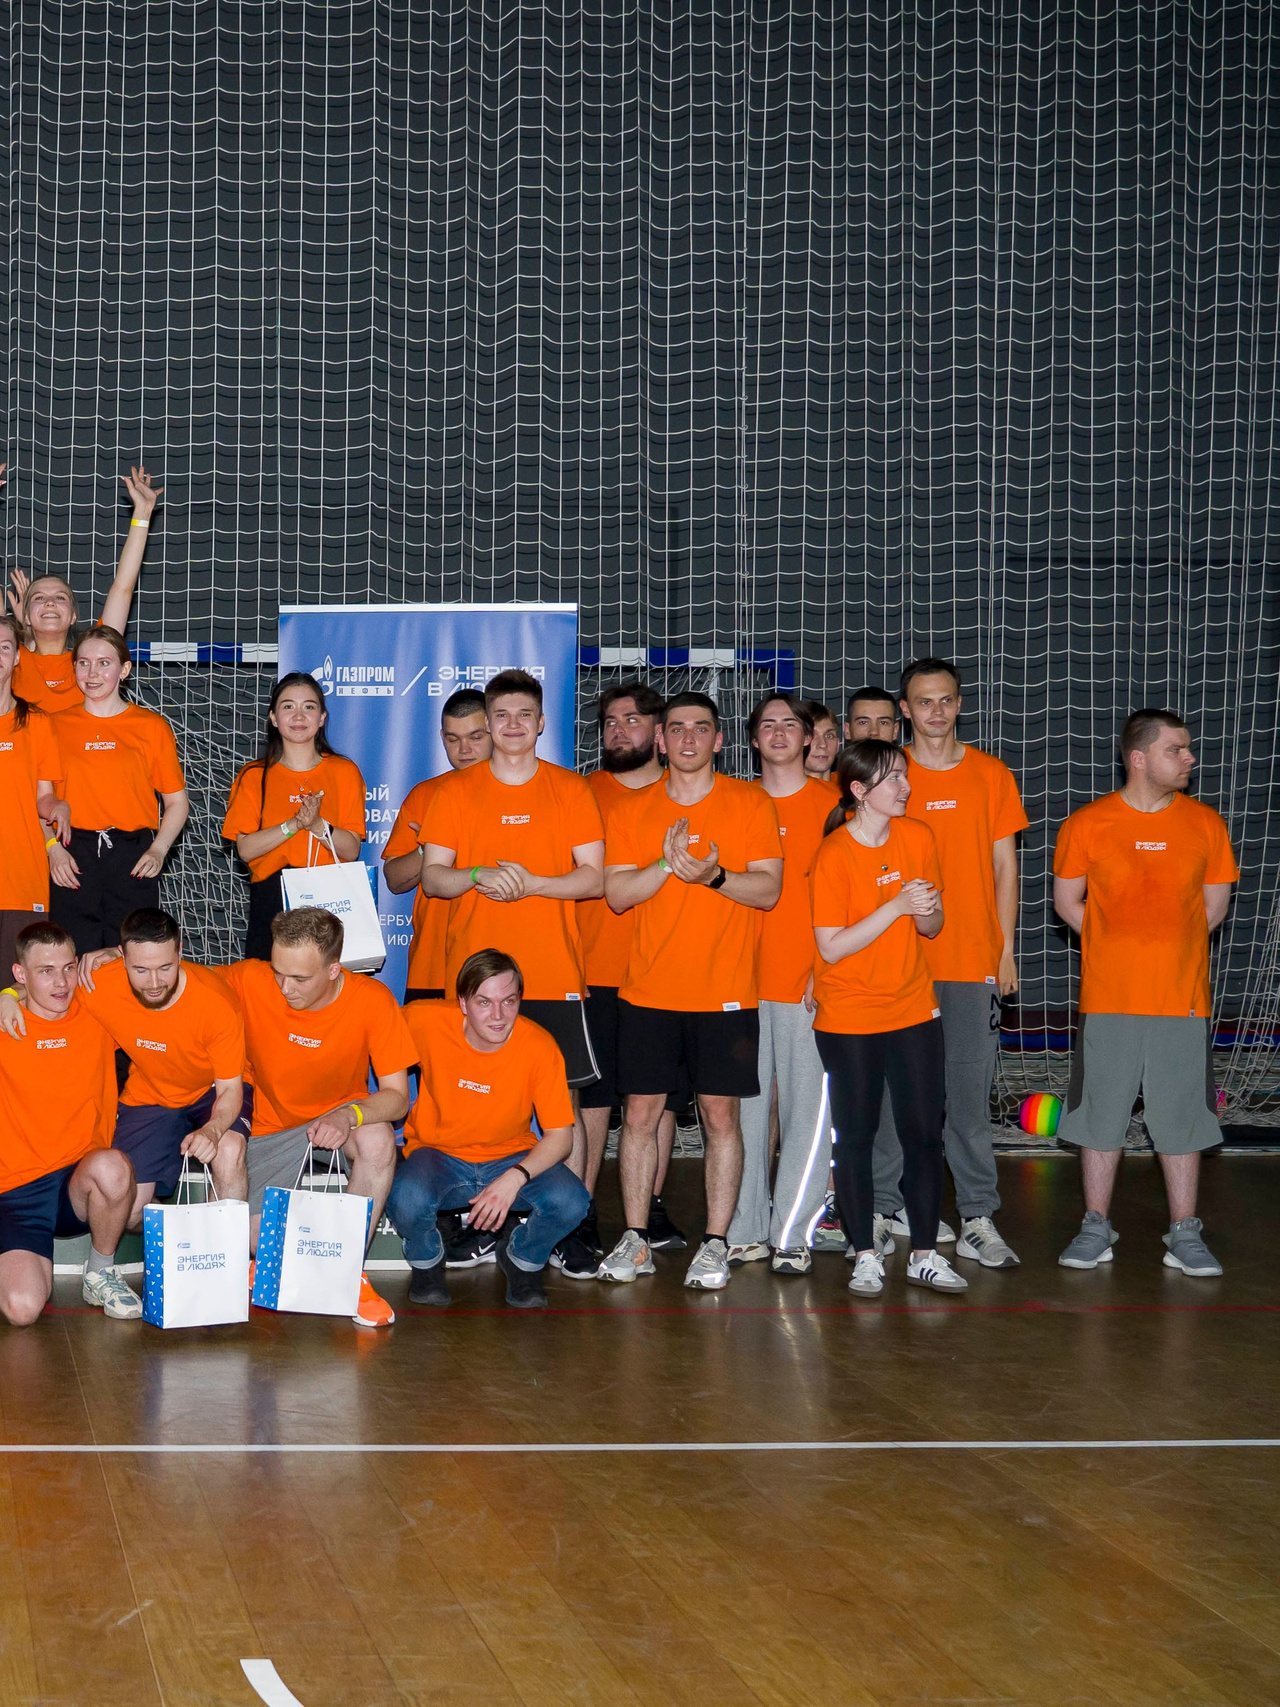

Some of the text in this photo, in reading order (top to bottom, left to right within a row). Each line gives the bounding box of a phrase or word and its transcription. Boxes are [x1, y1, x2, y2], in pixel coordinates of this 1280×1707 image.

[336, 666, 395, 682] ГАЗПРОМ
[438, 665, 545, 680] ЭНЕРЯ
[427, 682, 443, 696] В
[298, 1240, 342, 1250] ЭНЕРГИЯ
[178, 1253, 226, 1264] ЭНЕРГИЯ
[306, 1248, 342, 1258] ЛЮДЯХ
[188, 1262, 226, 1270] ЛЮДЯХ
